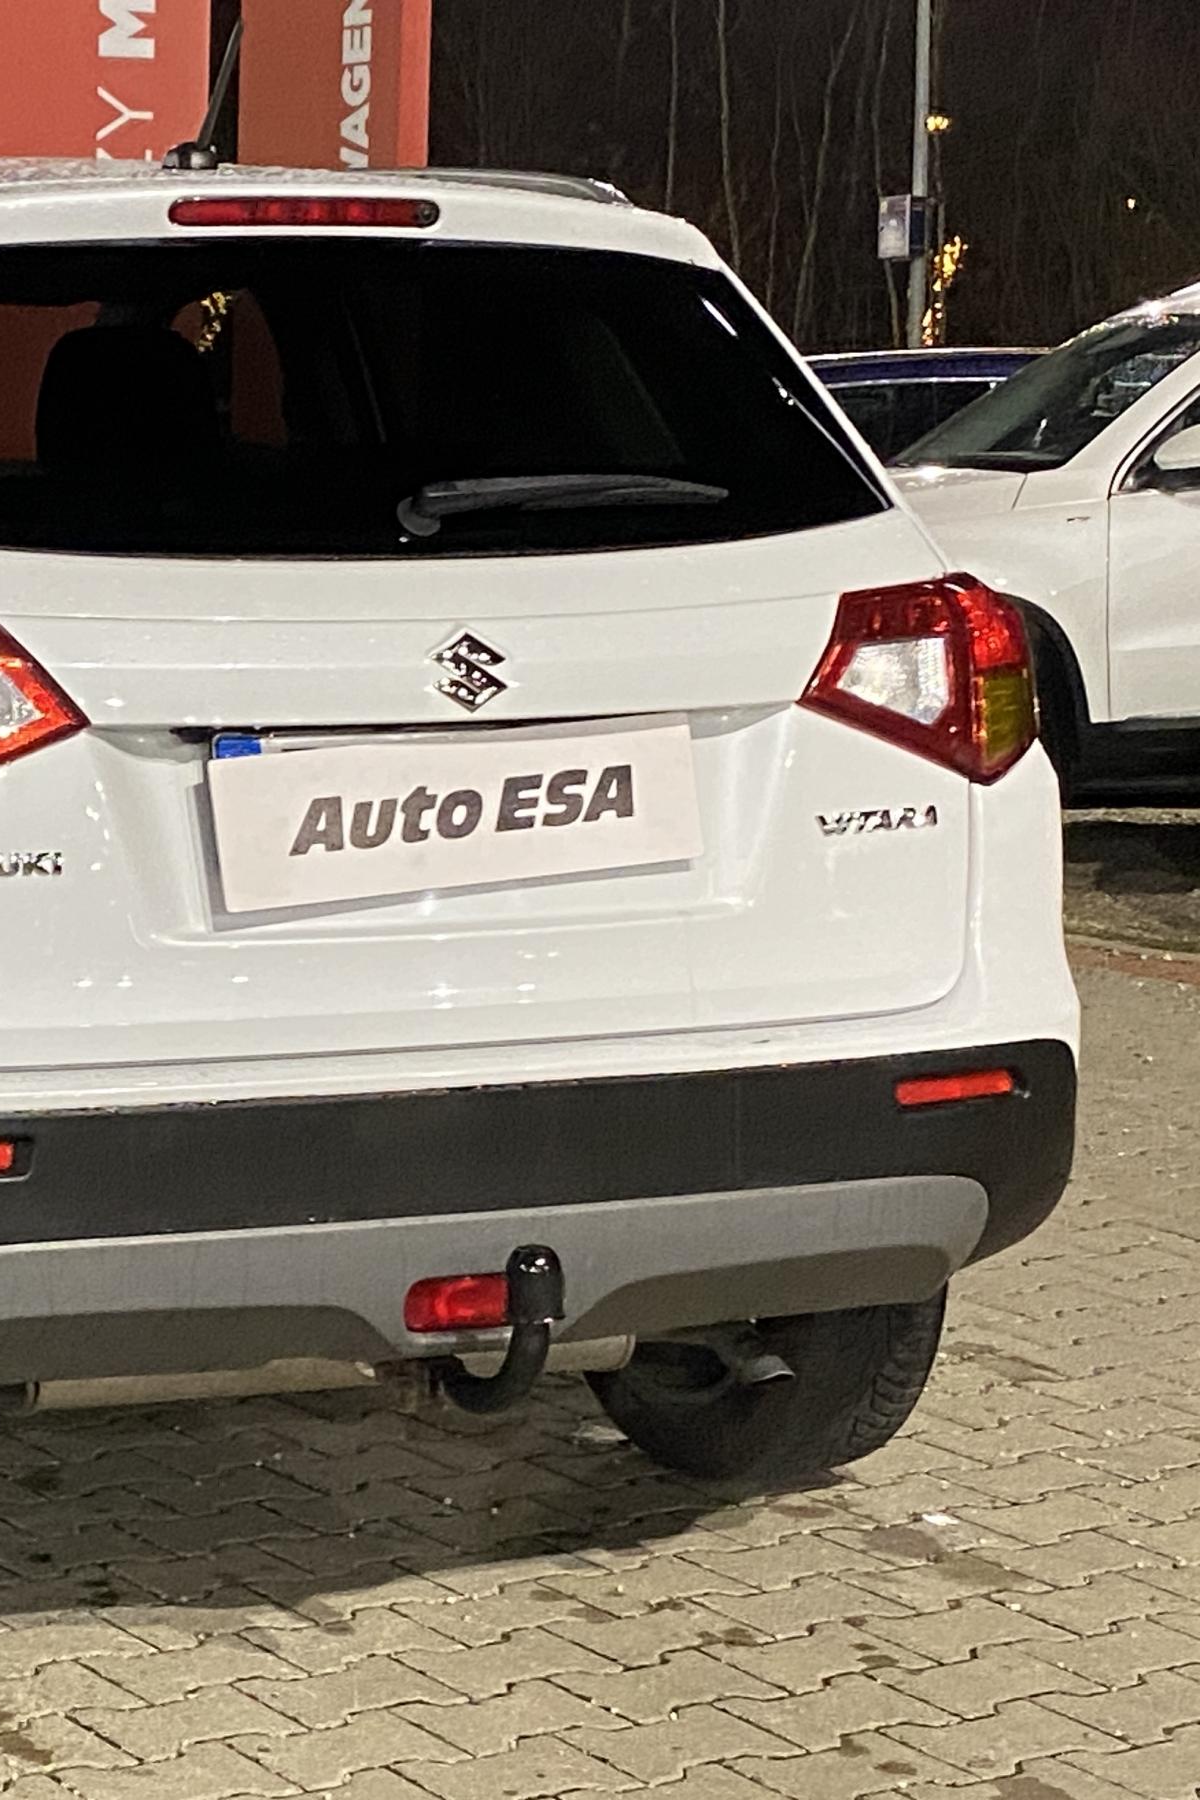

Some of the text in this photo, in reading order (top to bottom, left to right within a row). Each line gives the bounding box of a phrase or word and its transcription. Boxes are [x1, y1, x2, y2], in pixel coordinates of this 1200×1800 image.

[288, 764, 635, 857] Auto ESA
[815, 804, 938, 836] VITARA
